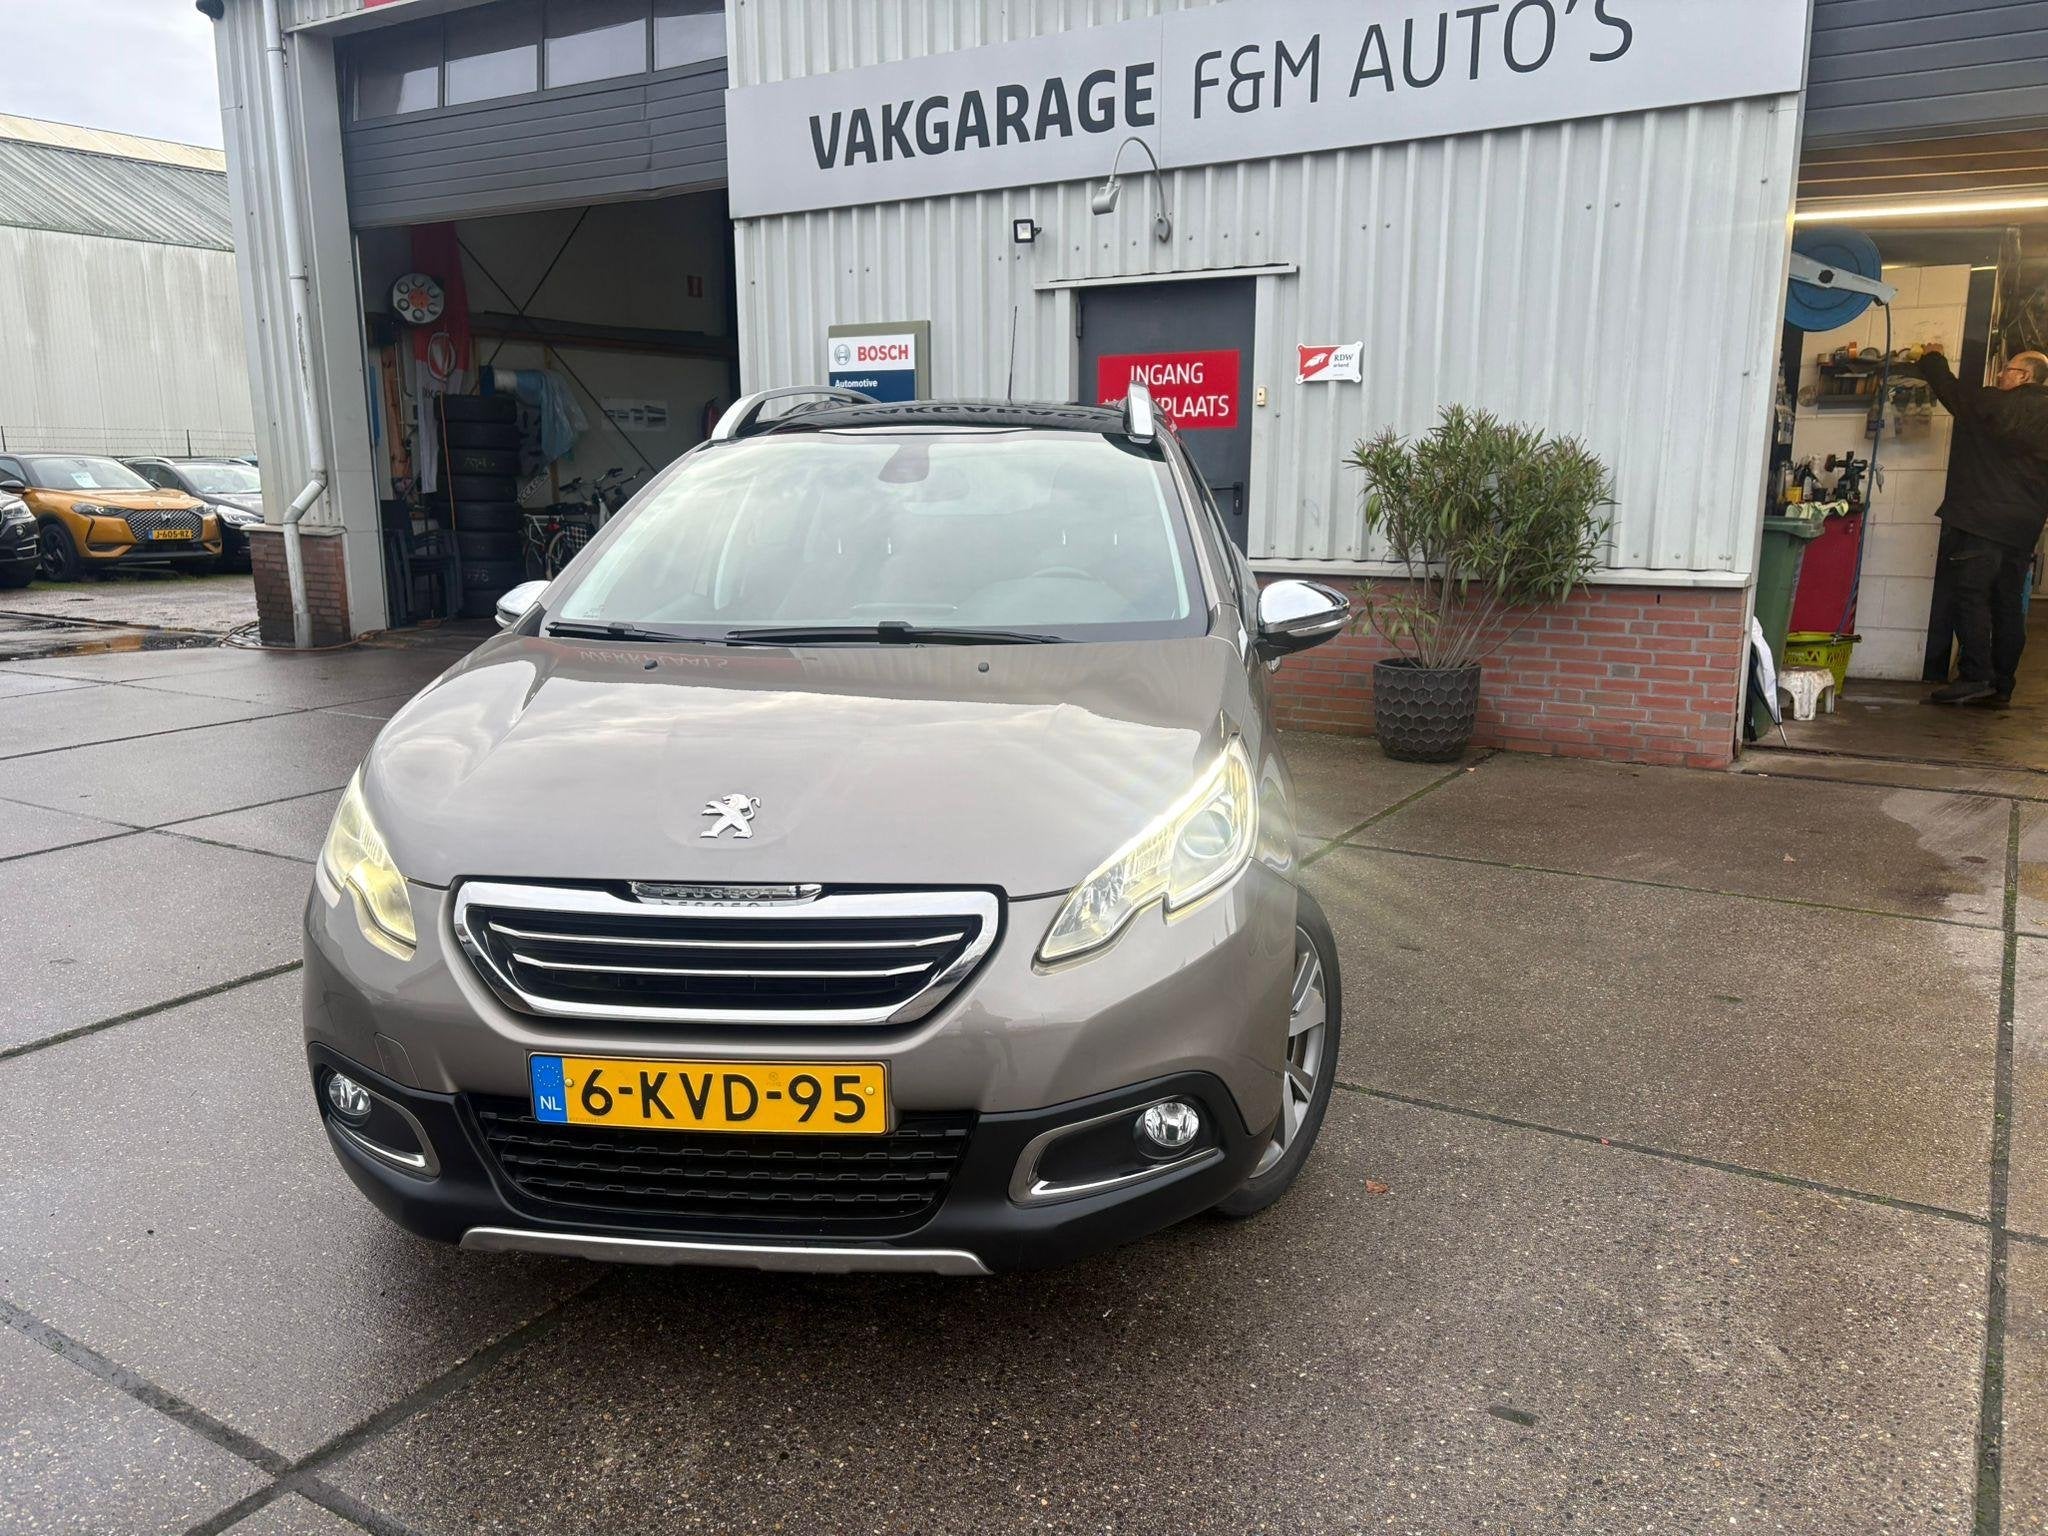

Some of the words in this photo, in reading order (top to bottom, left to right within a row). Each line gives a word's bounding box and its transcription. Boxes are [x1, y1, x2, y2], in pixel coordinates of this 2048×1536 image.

[809, 62, 1156, 170] VAKGARAGE
[1193, 34, 1321, 120] F&M
[1348, 0, 1633, 98] AUTO'S
[857, 344, 909, 362] BOSCH
[1334, 353, 1355, 362] RDW
[1130, 362, 1205, 386] INGANG
[834, 378, 879, 388] Automotive
[155, 529, 190, 539] J-605-RZ
[540, 1095, 562, 1111] NL
[581, 1068, 866, 1124] 6-KVD-95
